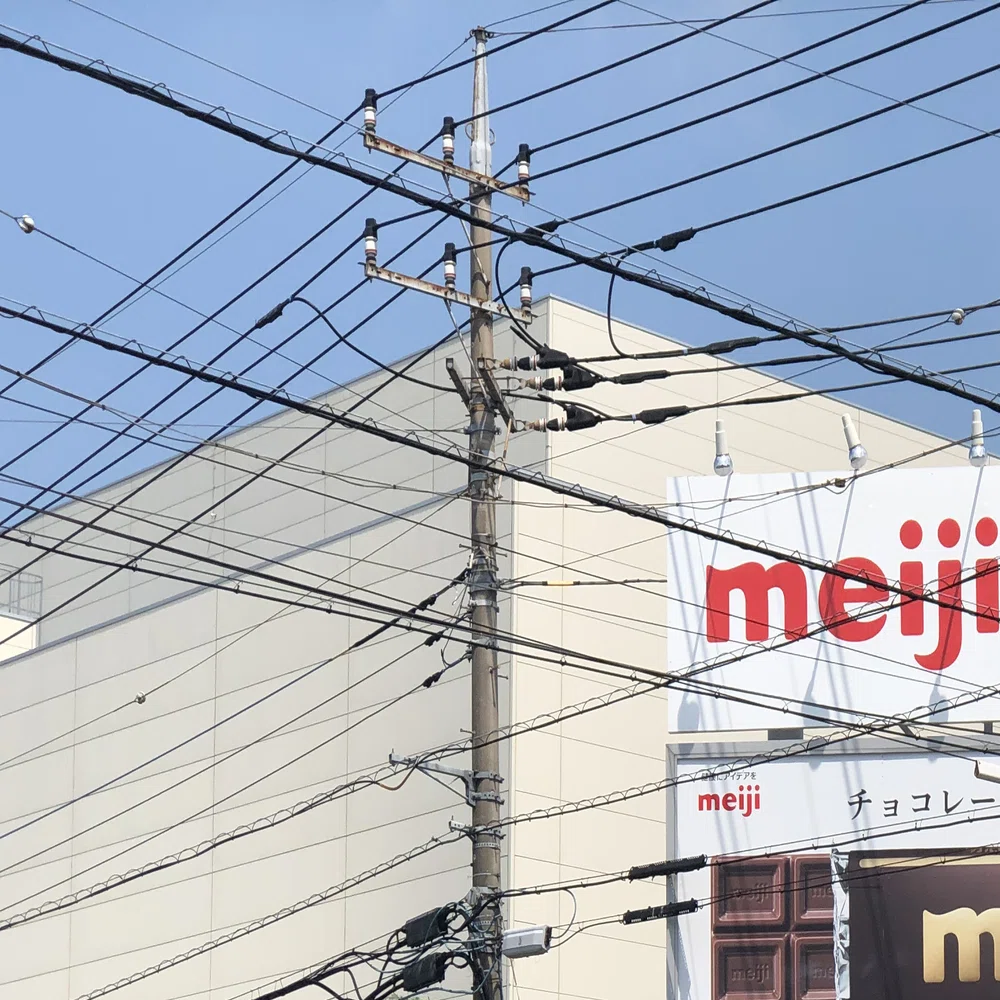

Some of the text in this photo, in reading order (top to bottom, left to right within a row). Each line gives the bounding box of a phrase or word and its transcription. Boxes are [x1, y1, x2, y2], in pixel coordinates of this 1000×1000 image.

[706, 516, 1000, 671] meiji
[698, 784, 760, 818] meiji
[731, 963, 771, 987] meiji
